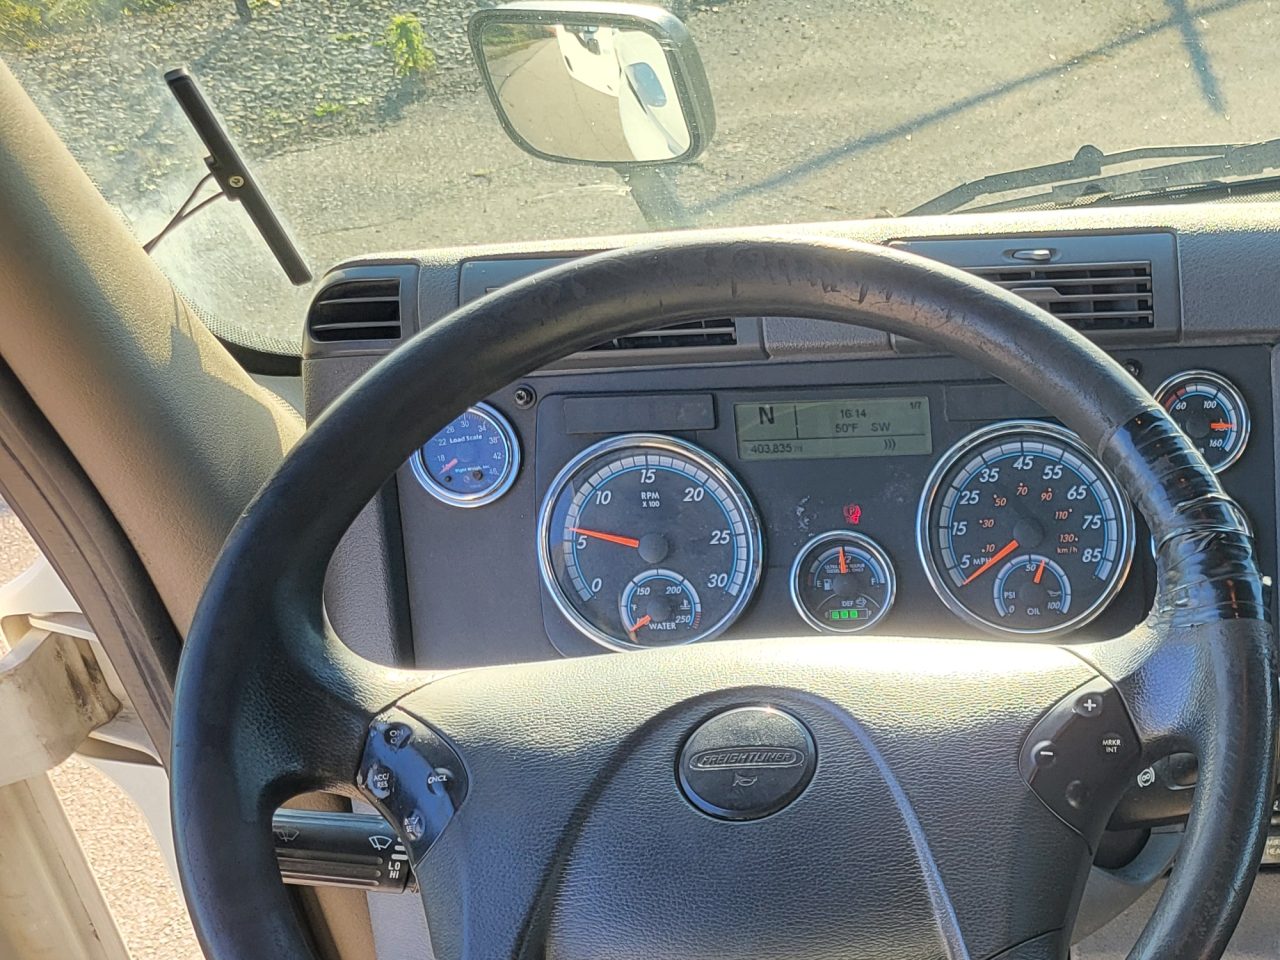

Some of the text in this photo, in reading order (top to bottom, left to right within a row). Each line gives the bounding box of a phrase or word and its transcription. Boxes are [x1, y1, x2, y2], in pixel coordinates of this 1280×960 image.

[910, 402, 921, 410] 1/7
[759, 406, 775, 424] N
[840, 409, 867, 418] 16:14
[835, 423, 890, 433] 50°F SW
[1013, 456, 1033, 470] 45
[640, 469, 655, 483] 15
[979, 469, 999, 482] 35
[1043, 465, 1063, 479] 55
[596, 491, 611, 504] 10
[683, 487, 704, 501] 20
[960, 491, 979, 504] 25
[1017, 487, 1027, 495] 70
[1041, 492, 1052, 500] 90
[1067, 486, 1087, 499] 65
[995, 498, 1006, 506] 50
[1055, 511, 1068, 519] 110
[952, 522, 967, 535] 15
[1082, 516, 1101, 529] 75
[577, 536, 587, 549] 5
[710, 531, 730, 544] 25
[1060, 534, 1074, 542] 130
[961, 555, 970, 568] 5
[1082, 549, 1102, 562] 85
[592, 578, 602, 591] 0
[708, 574, 727, 587] 30
[637, 587, 650, 595] 150
[665, 586, 681, 594] 200
[700, 751, 791, 765] FREIGHTLINER
[388, 861, 400, 870] LO
